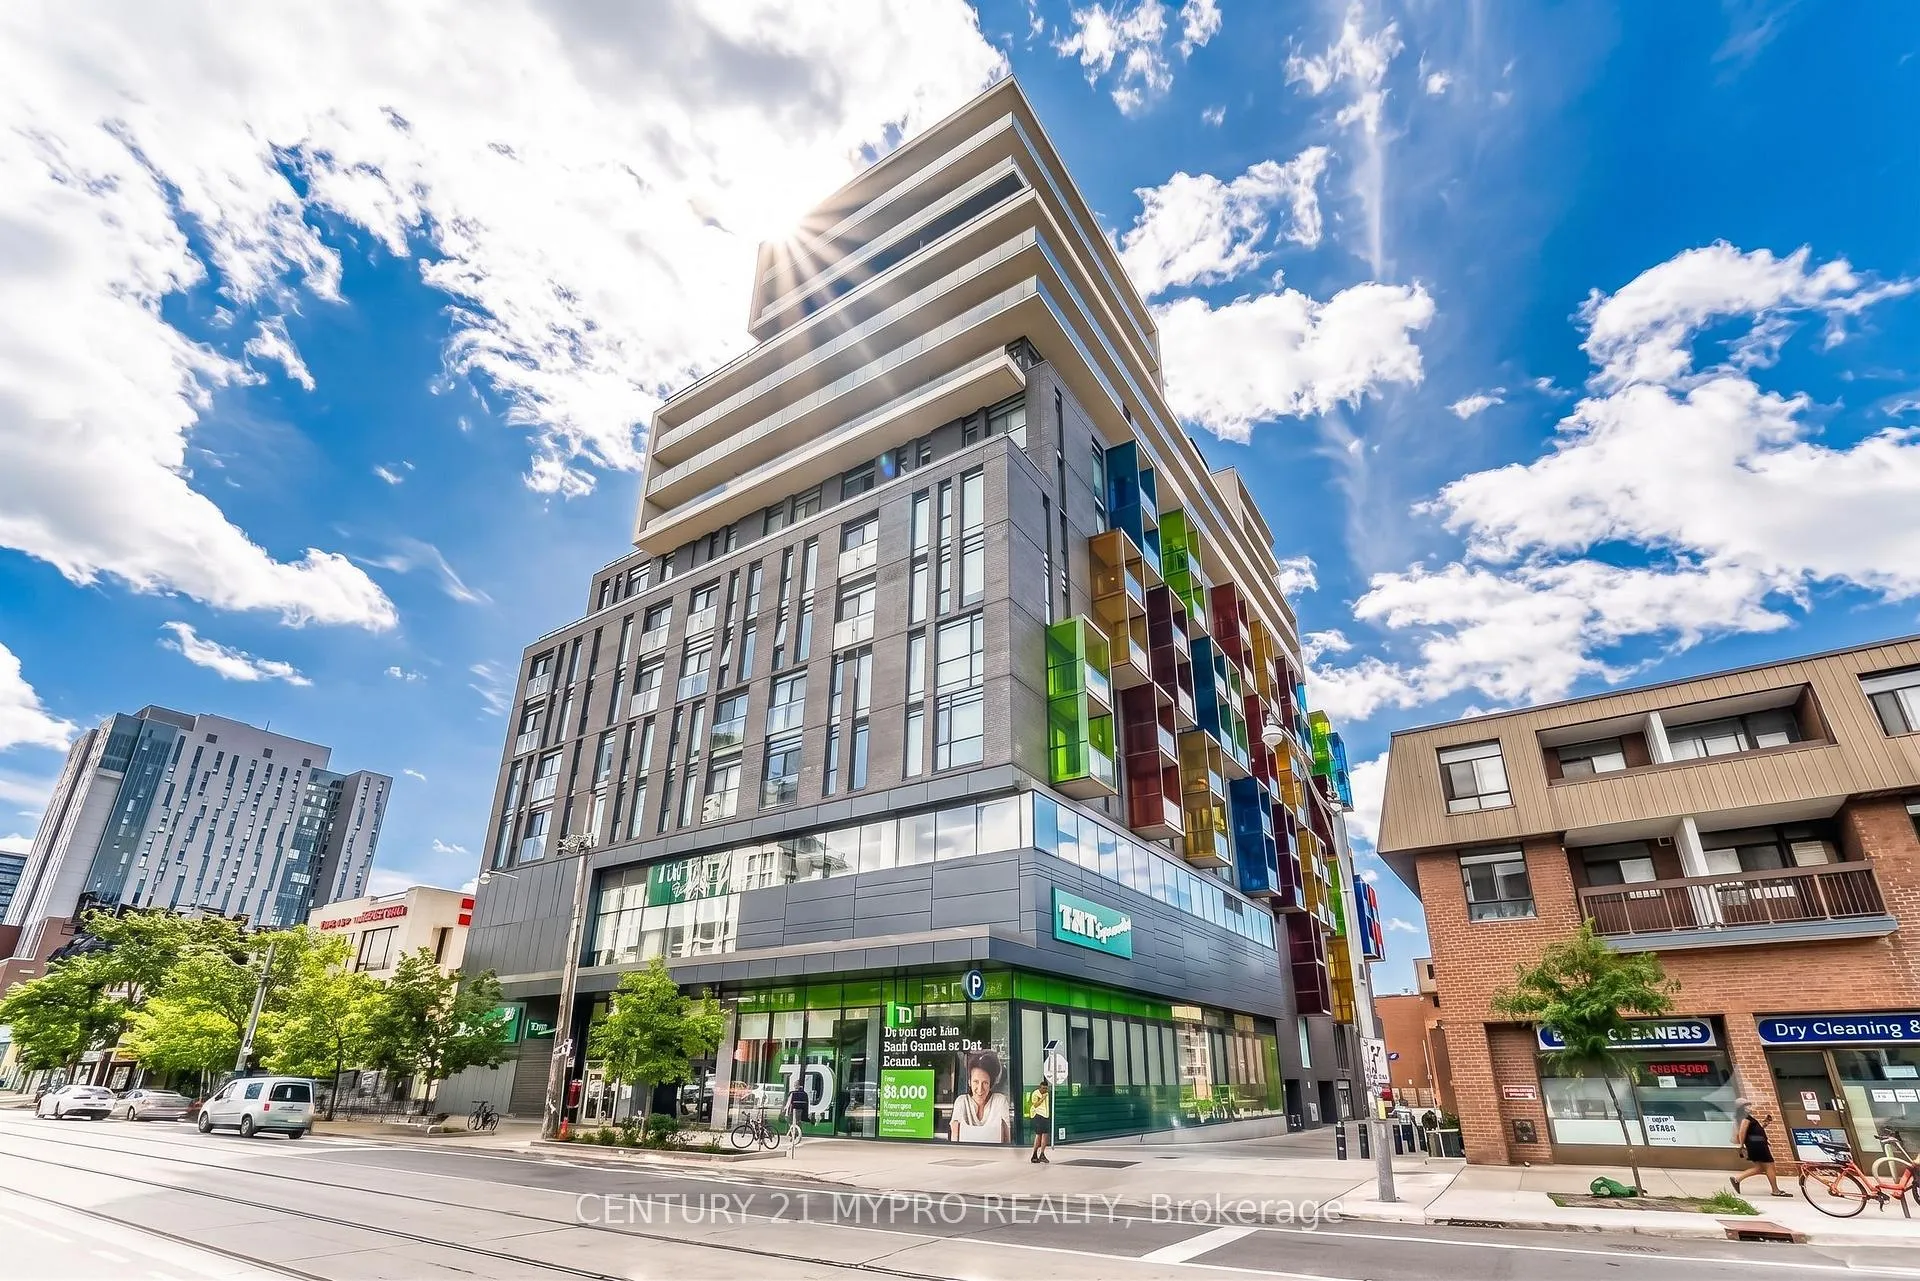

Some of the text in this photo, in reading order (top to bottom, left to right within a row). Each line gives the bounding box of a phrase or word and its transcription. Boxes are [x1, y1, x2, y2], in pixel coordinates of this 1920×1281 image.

[972, 975, 981, 996] P
[920, 1026, 937, 1040] get
[1775, 1023, 1806, 1039] Dry
[1813, 1021, 1903, 1038] Cleaning
[962, 1039, 982, 1051] Dat
